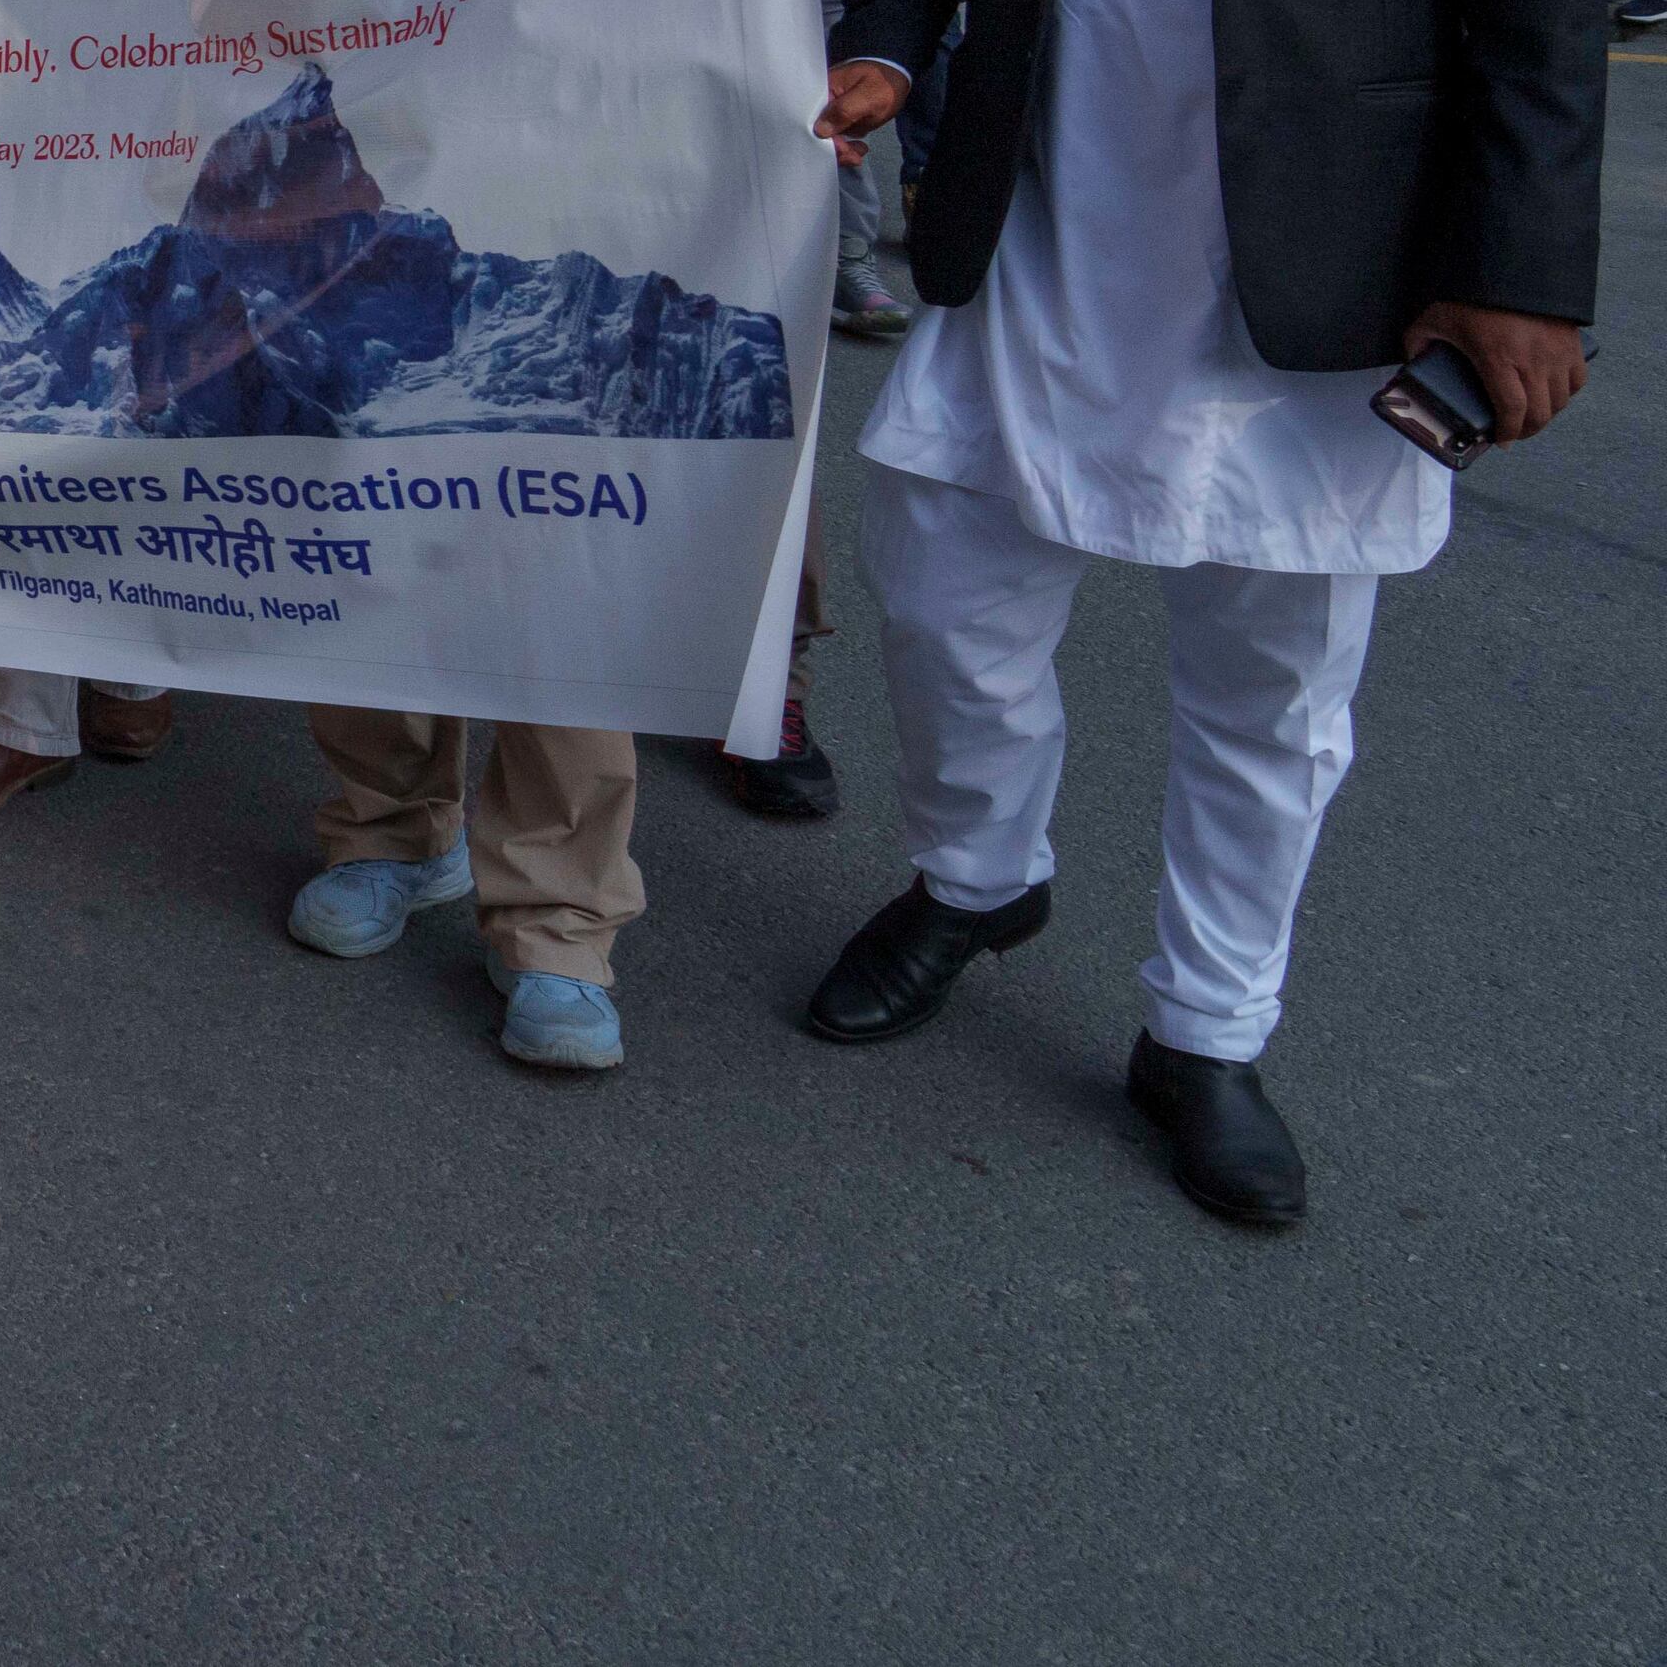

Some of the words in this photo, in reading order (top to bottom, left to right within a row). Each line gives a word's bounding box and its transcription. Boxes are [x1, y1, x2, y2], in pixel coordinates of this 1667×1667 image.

[70, 32, 264, 76] Celebrating
[109, 130, 199, 163] Monday
[182, 466, 482, 513] Assocation
[498, 465, 648, 526] (ESA)
[135, 514, 275, 579] आरोही
[285, 527, 372, 576] संघ
[108, 579, 255, 622] Kathmandu,
[261, 596, 341, 626] Nepal
